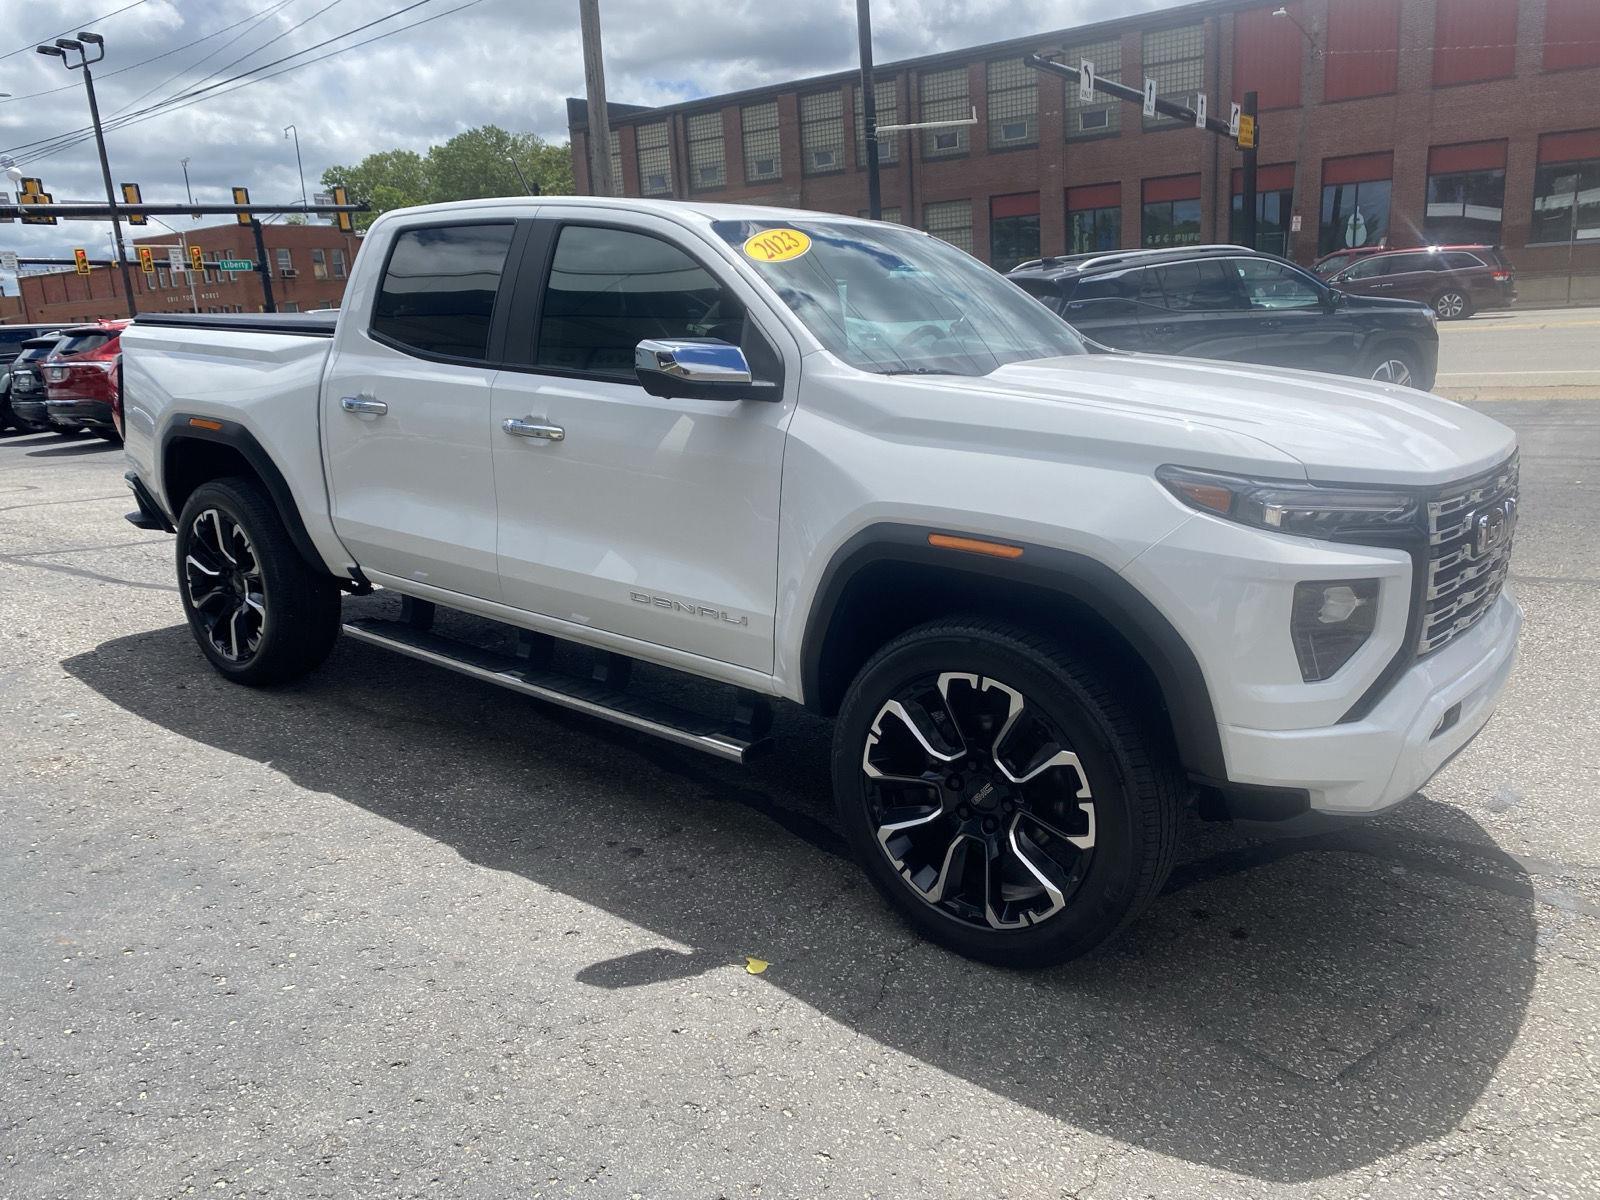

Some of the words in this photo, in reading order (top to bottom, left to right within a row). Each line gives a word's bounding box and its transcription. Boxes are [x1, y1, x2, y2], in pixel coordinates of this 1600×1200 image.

[755, 231, 800, 260] 2023
[223, 260, 250, 269] Liberty
[630, 591, 748, 627] DENALI
[971, 783, 994, 805] GMC
